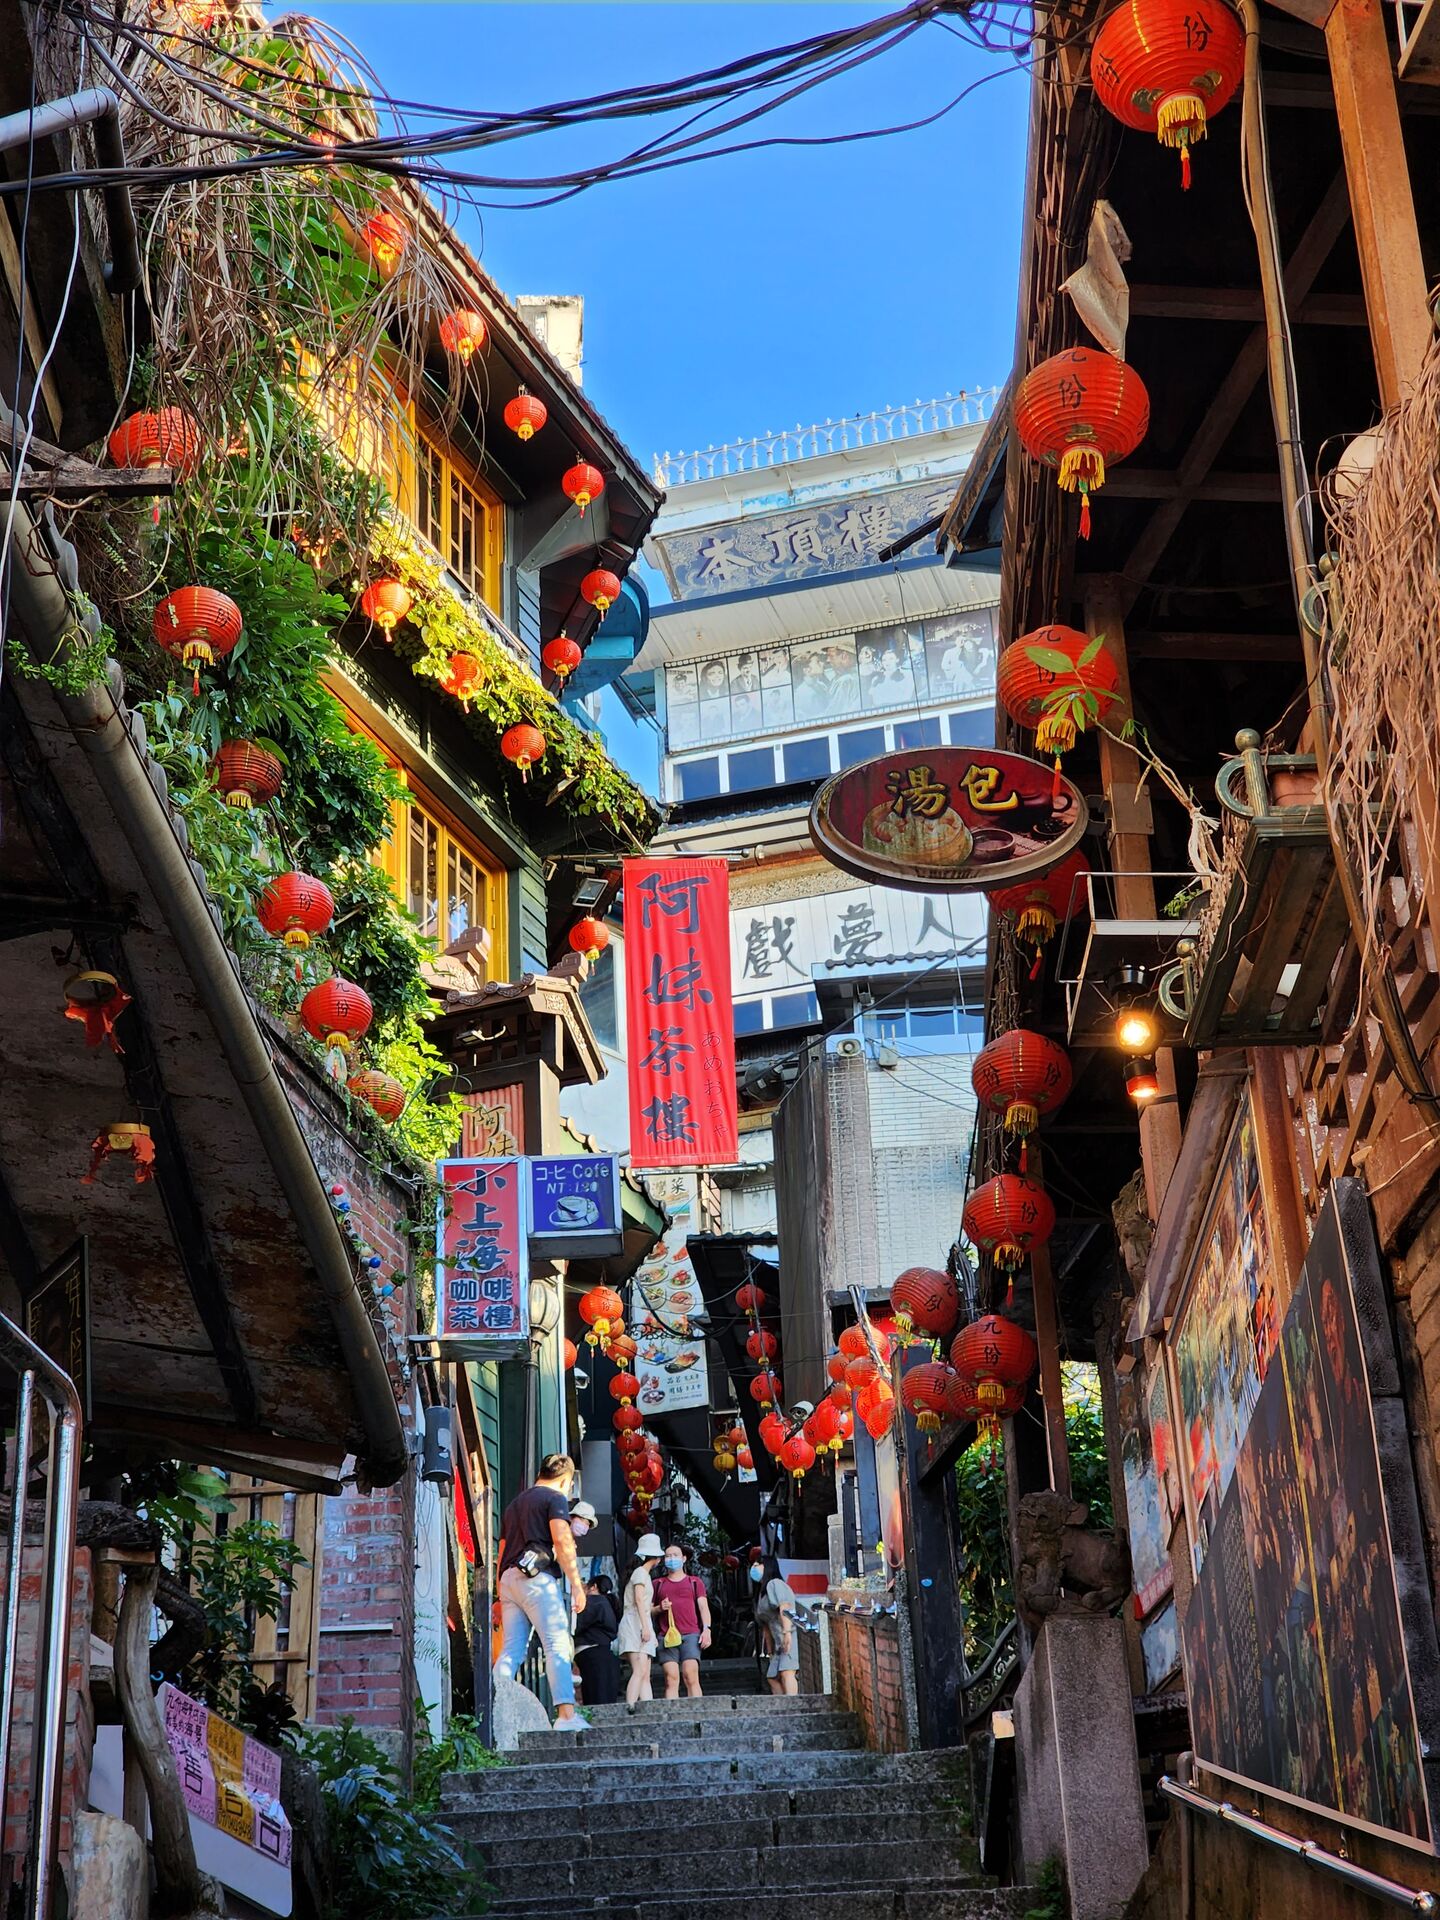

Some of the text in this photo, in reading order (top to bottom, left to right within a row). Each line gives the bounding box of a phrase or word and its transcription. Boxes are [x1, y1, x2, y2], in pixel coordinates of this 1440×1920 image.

[886, 762, 1020, 819] 湯包
[742, 896, 975, 980] 戲夢人
[636, 872, 714, 1145] 阿妹茶樓
[455, 1168, 512, 1274] 小上海
[449, 1276, 514, 1303] 咖啡
[449, 1304, 515, 1330] 茶樓
[982, 1321, 1003, 1366] 九份
